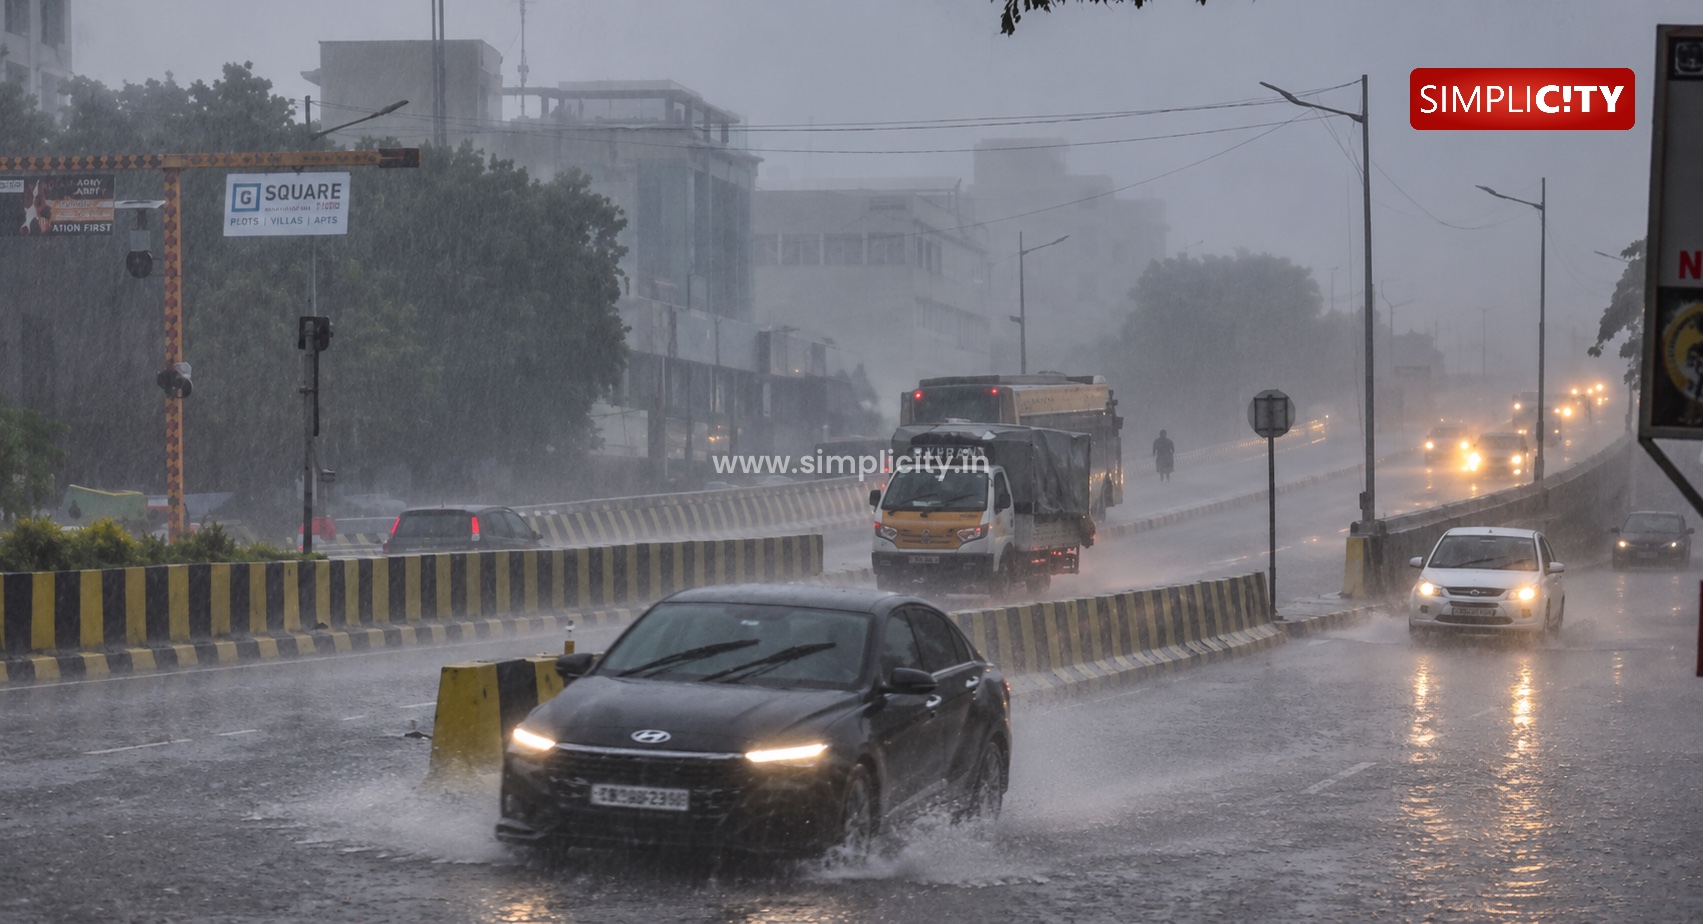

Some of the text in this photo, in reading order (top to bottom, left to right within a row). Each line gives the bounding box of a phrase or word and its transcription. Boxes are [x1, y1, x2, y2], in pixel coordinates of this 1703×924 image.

[240, 183, 342, 205] G SQUARE
[230, 215, 338, 226] PLOTS VILLAS APTS
[52, 223, 112, 233] ATION FIRST
